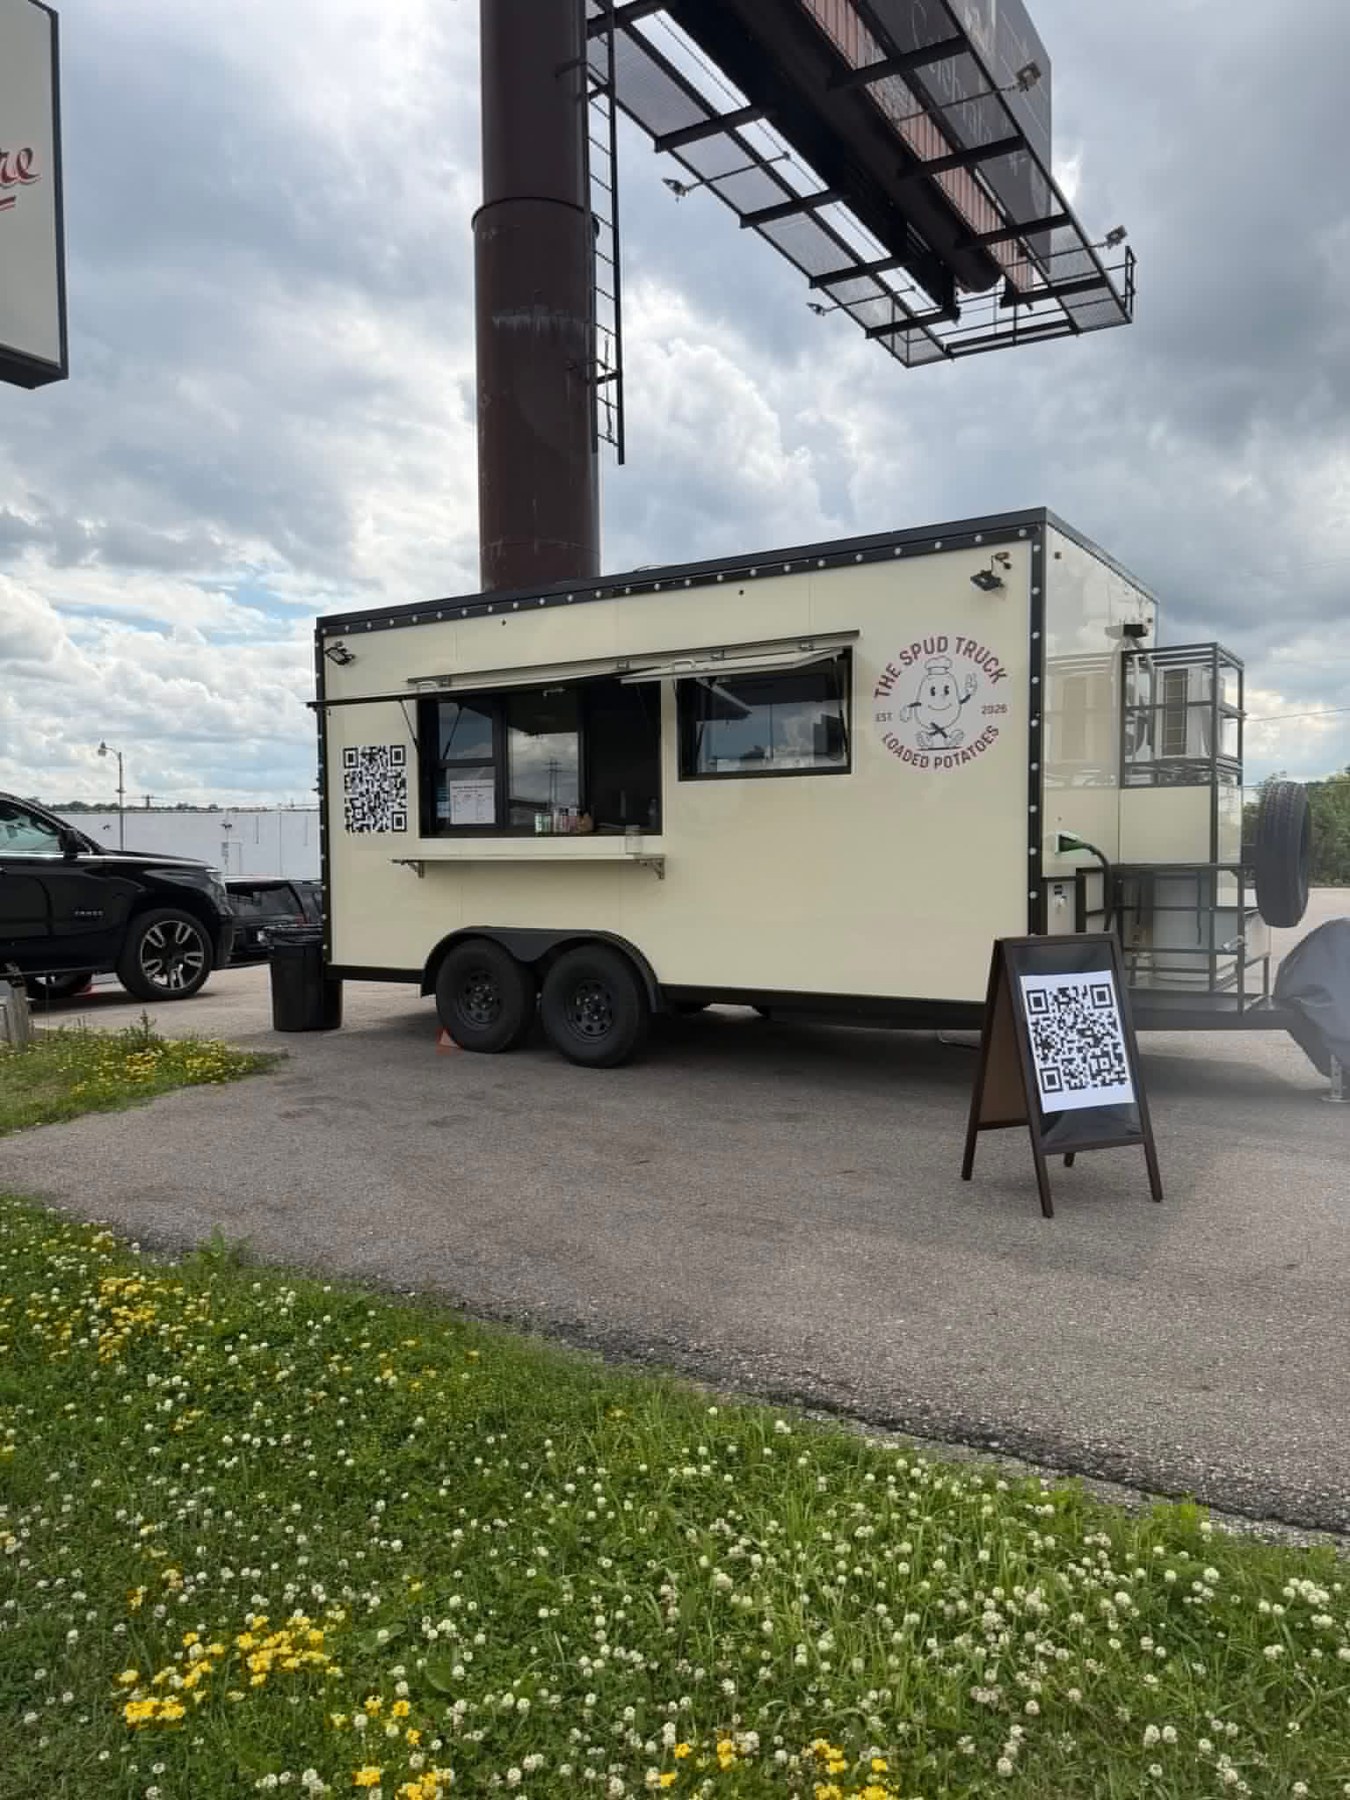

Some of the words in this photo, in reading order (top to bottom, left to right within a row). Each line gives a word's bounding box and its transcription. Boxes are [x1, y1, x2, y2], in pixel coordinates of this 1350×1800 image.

[873, 663, 901, 698] THE
[899, 636, 948, 666] SPUD
[955, 636, 1007, 684] TRUCK
[882, 732, 929, 768] LOADED
[934, 725, 999, 769] POTATOES
